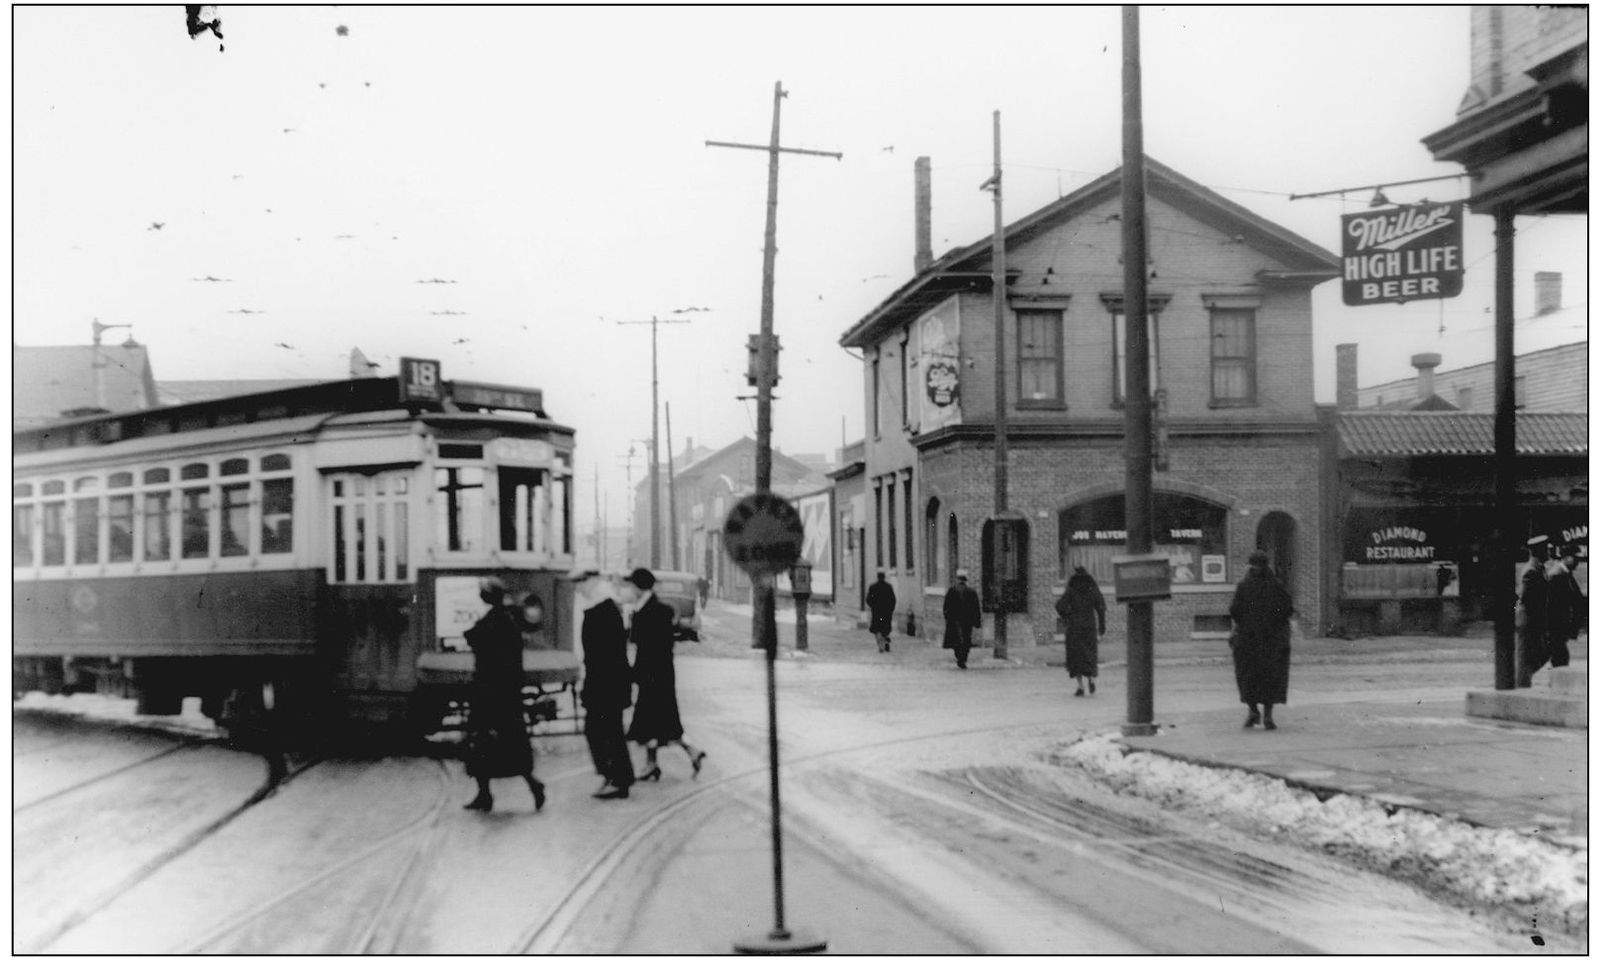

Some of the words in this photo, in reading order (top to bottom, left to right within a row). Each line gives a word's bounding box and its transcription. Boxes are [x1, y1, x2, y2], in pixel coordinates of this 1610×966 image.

[1348, 204, 1452, 250] Miller
[1344, 252, 1401, 281] HIGH
[1407, 246, 1459, 274] LIFE
[1362, 277, 1440, 299] BEER
[411, 361, 436, 386] 18
[1170, 528, 1203, 538] TAVERN
[1372, 526, 1427, 544] DIAMOND
[1366, 546, 1435, 559] RESTAURANT
